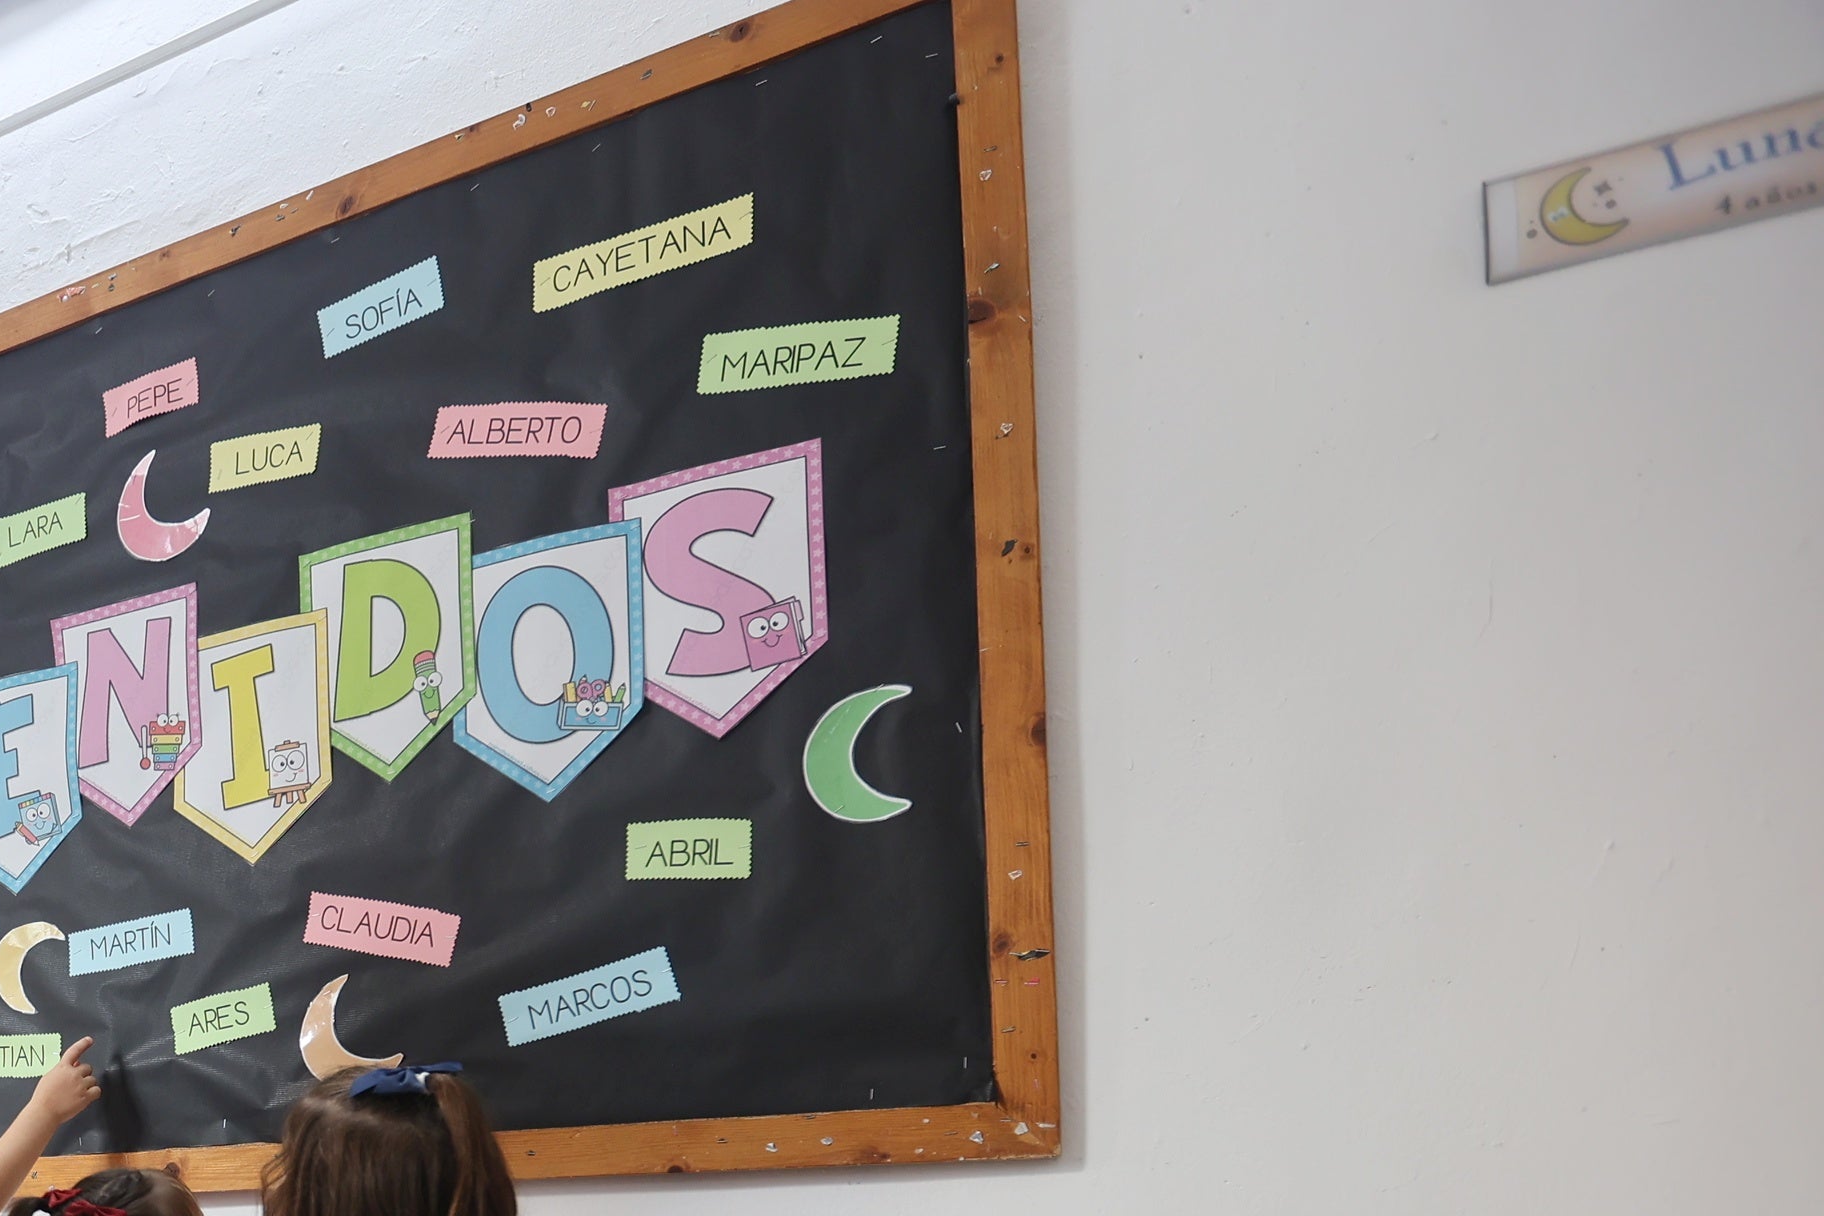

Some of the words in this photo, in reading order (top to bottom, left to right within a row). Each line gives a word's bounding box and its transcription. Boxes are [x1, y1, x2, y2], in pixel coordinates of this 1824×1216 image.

[552, 216, 731, 292] CAYETANA
[345, 287, 423, 339] SOFÍA
[721, 336, 867, 383] MARIPAZ
[126, 377, 184, 419] PEPE
[446, 415, 583, 446] ALBERTO
[234, 440, 304, 475] LUCA
[7, 511, 64, 548] LARA
[645, 838, 735, 868] ABRIL
[89, 920, 172, 961] MARTÍN
[320, 904, 435, 948] CLAUDIA
[187, 1000, 251, 1038] ARES
[527, 968, 654, 1030] MARCOS
